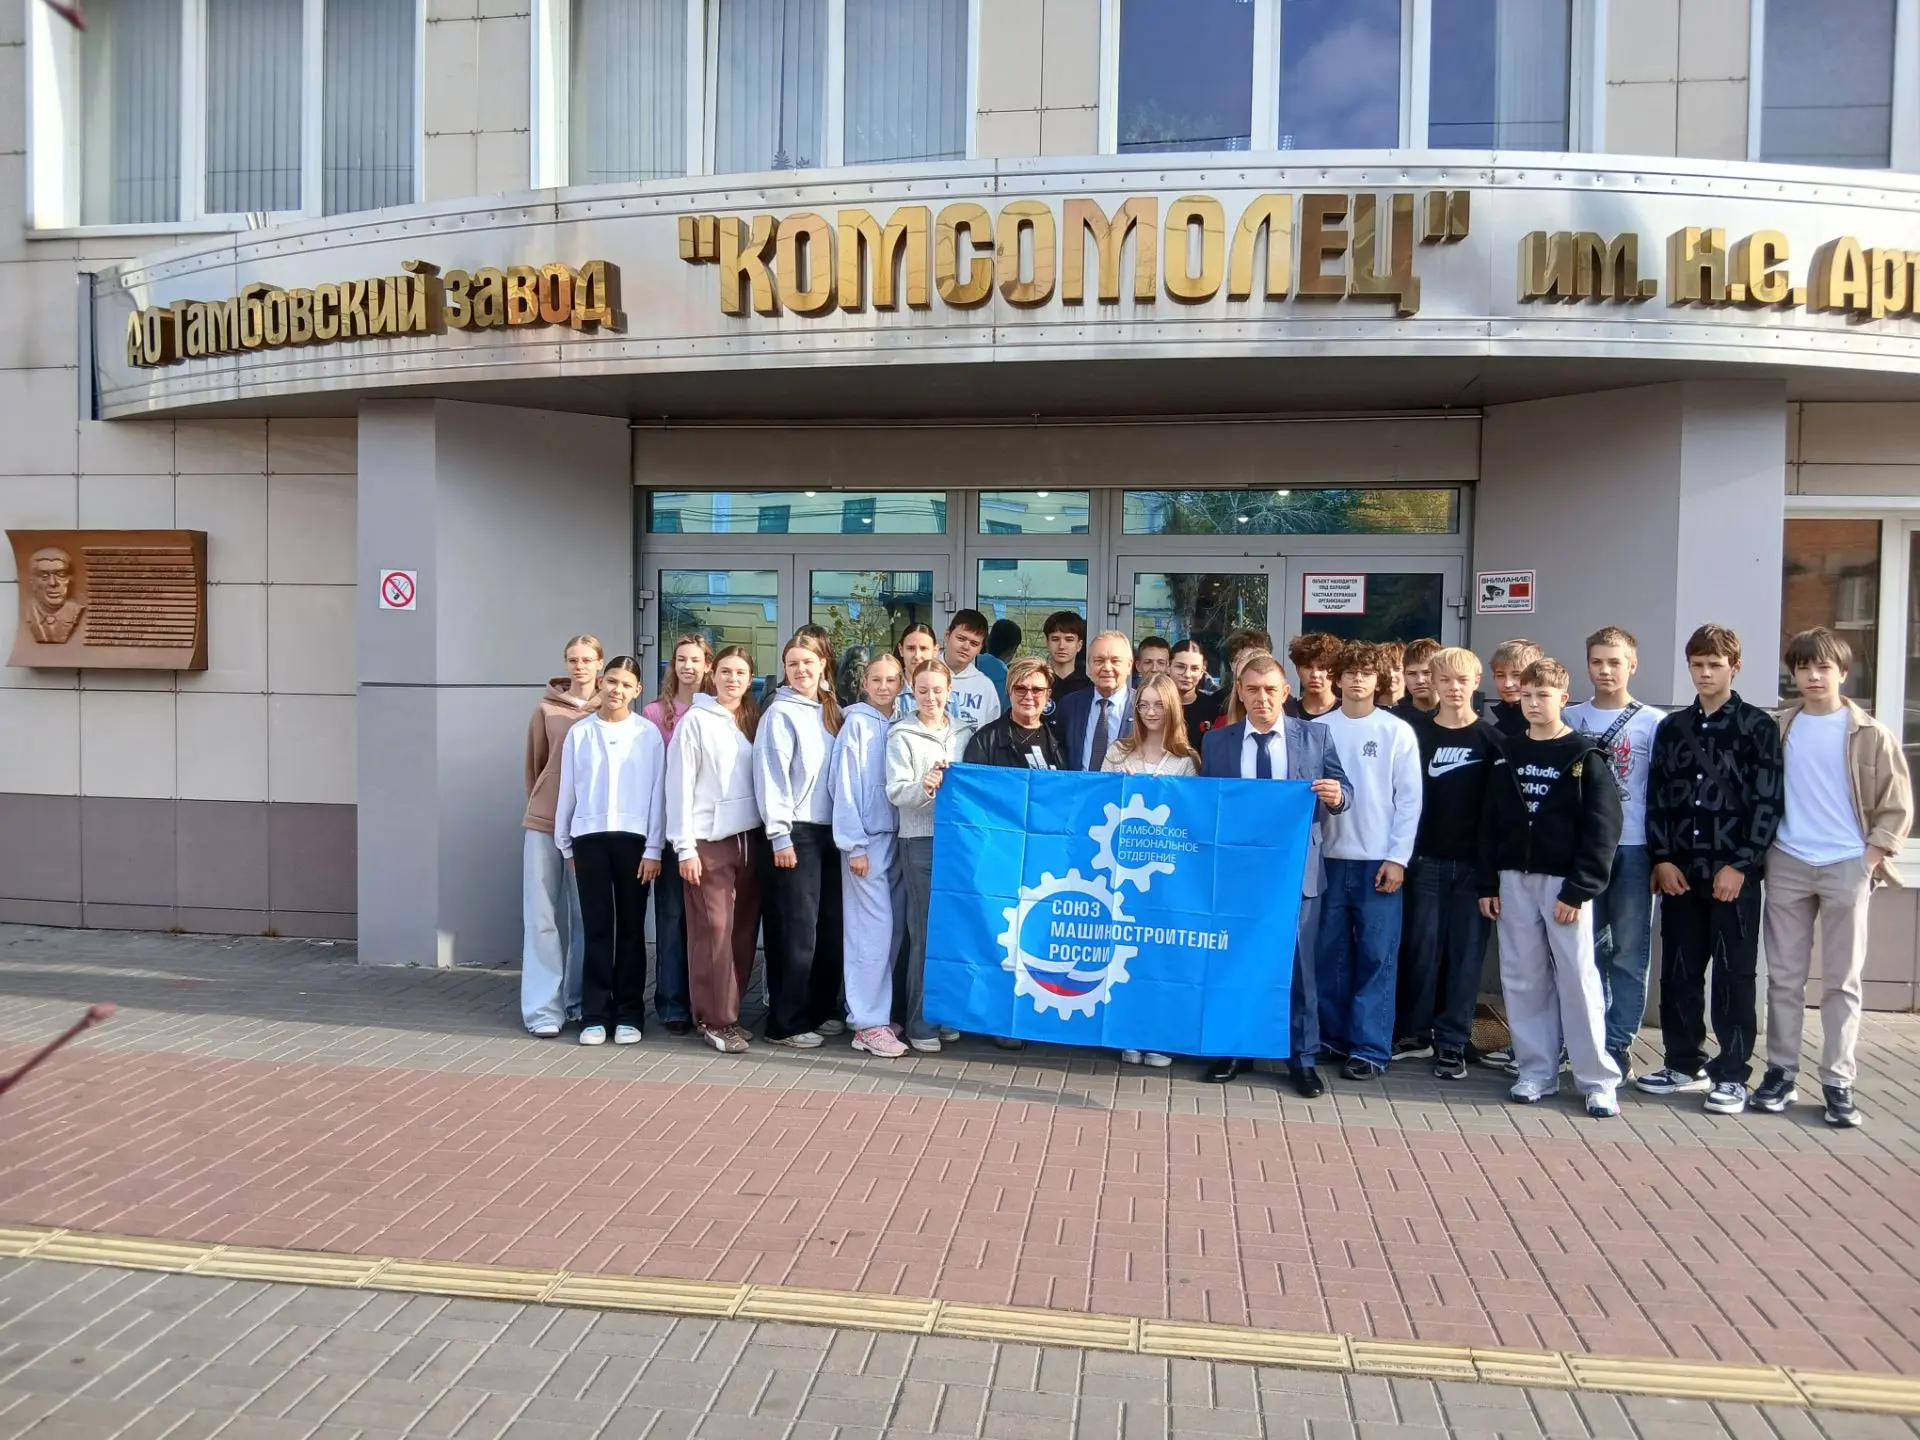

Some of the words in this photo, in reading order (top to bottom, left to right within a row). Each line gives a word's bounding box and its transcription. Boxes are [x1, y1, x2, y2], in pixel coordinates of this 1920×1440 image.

[127, 304, 167, 368] АО
[171, 259, 440, 360] Тамбовский
[443, 260, 622, 333] завод
[678, 190, 1470, 318] "КОМСОМОЛЕЦ"
[1518, 230, 1658, 303] им.
[1433, 747, 1473, 764] NIKE
[1119, 824, 1189, 839] ТАМБОВСКОЕ
[1119, 837, 1199, 853] РЕГИОНАЛЬНОЕ
[1118, 850, 1177, 863] ОТДЕЛЕНИЕ
[1051, 899, 1101, 918] СОЮЗ
[1050, 920, 1229, 951] МАШИНОСТРОИТЕЛЕЙ
[1049, 943, 1110, 963] РОССИИ
